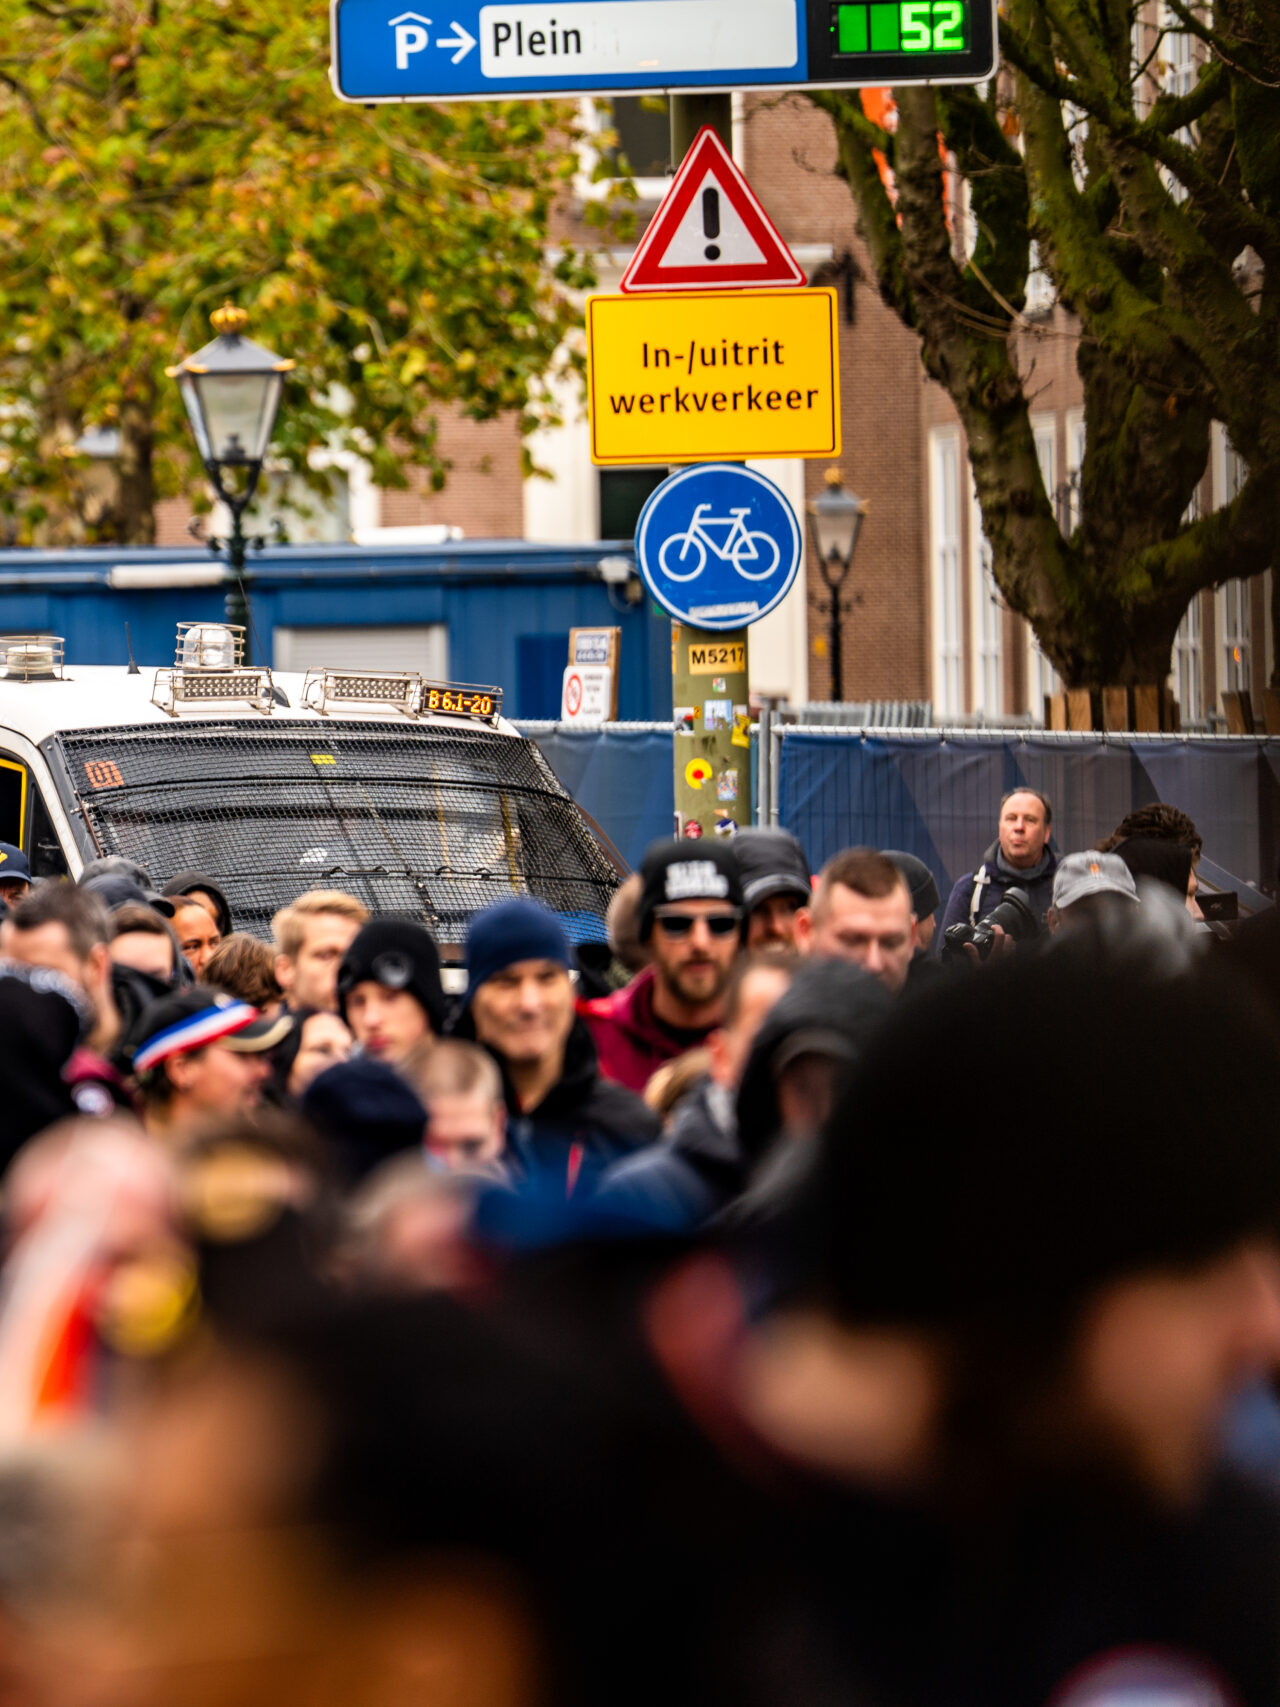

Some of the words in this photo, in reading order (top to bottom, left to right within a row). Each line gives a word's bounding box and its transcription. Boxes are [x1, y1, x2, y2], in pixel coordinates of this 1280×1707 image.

[492, 19, 582, 57] Plein
[900, 1, 964, 51] 52
[641, 337, 786, 376] In-/uitrit
[609, 384, 820, 414] werkverkeer
[691, 646, 745, 665] M5217
[428, 690, 440, 710] B
